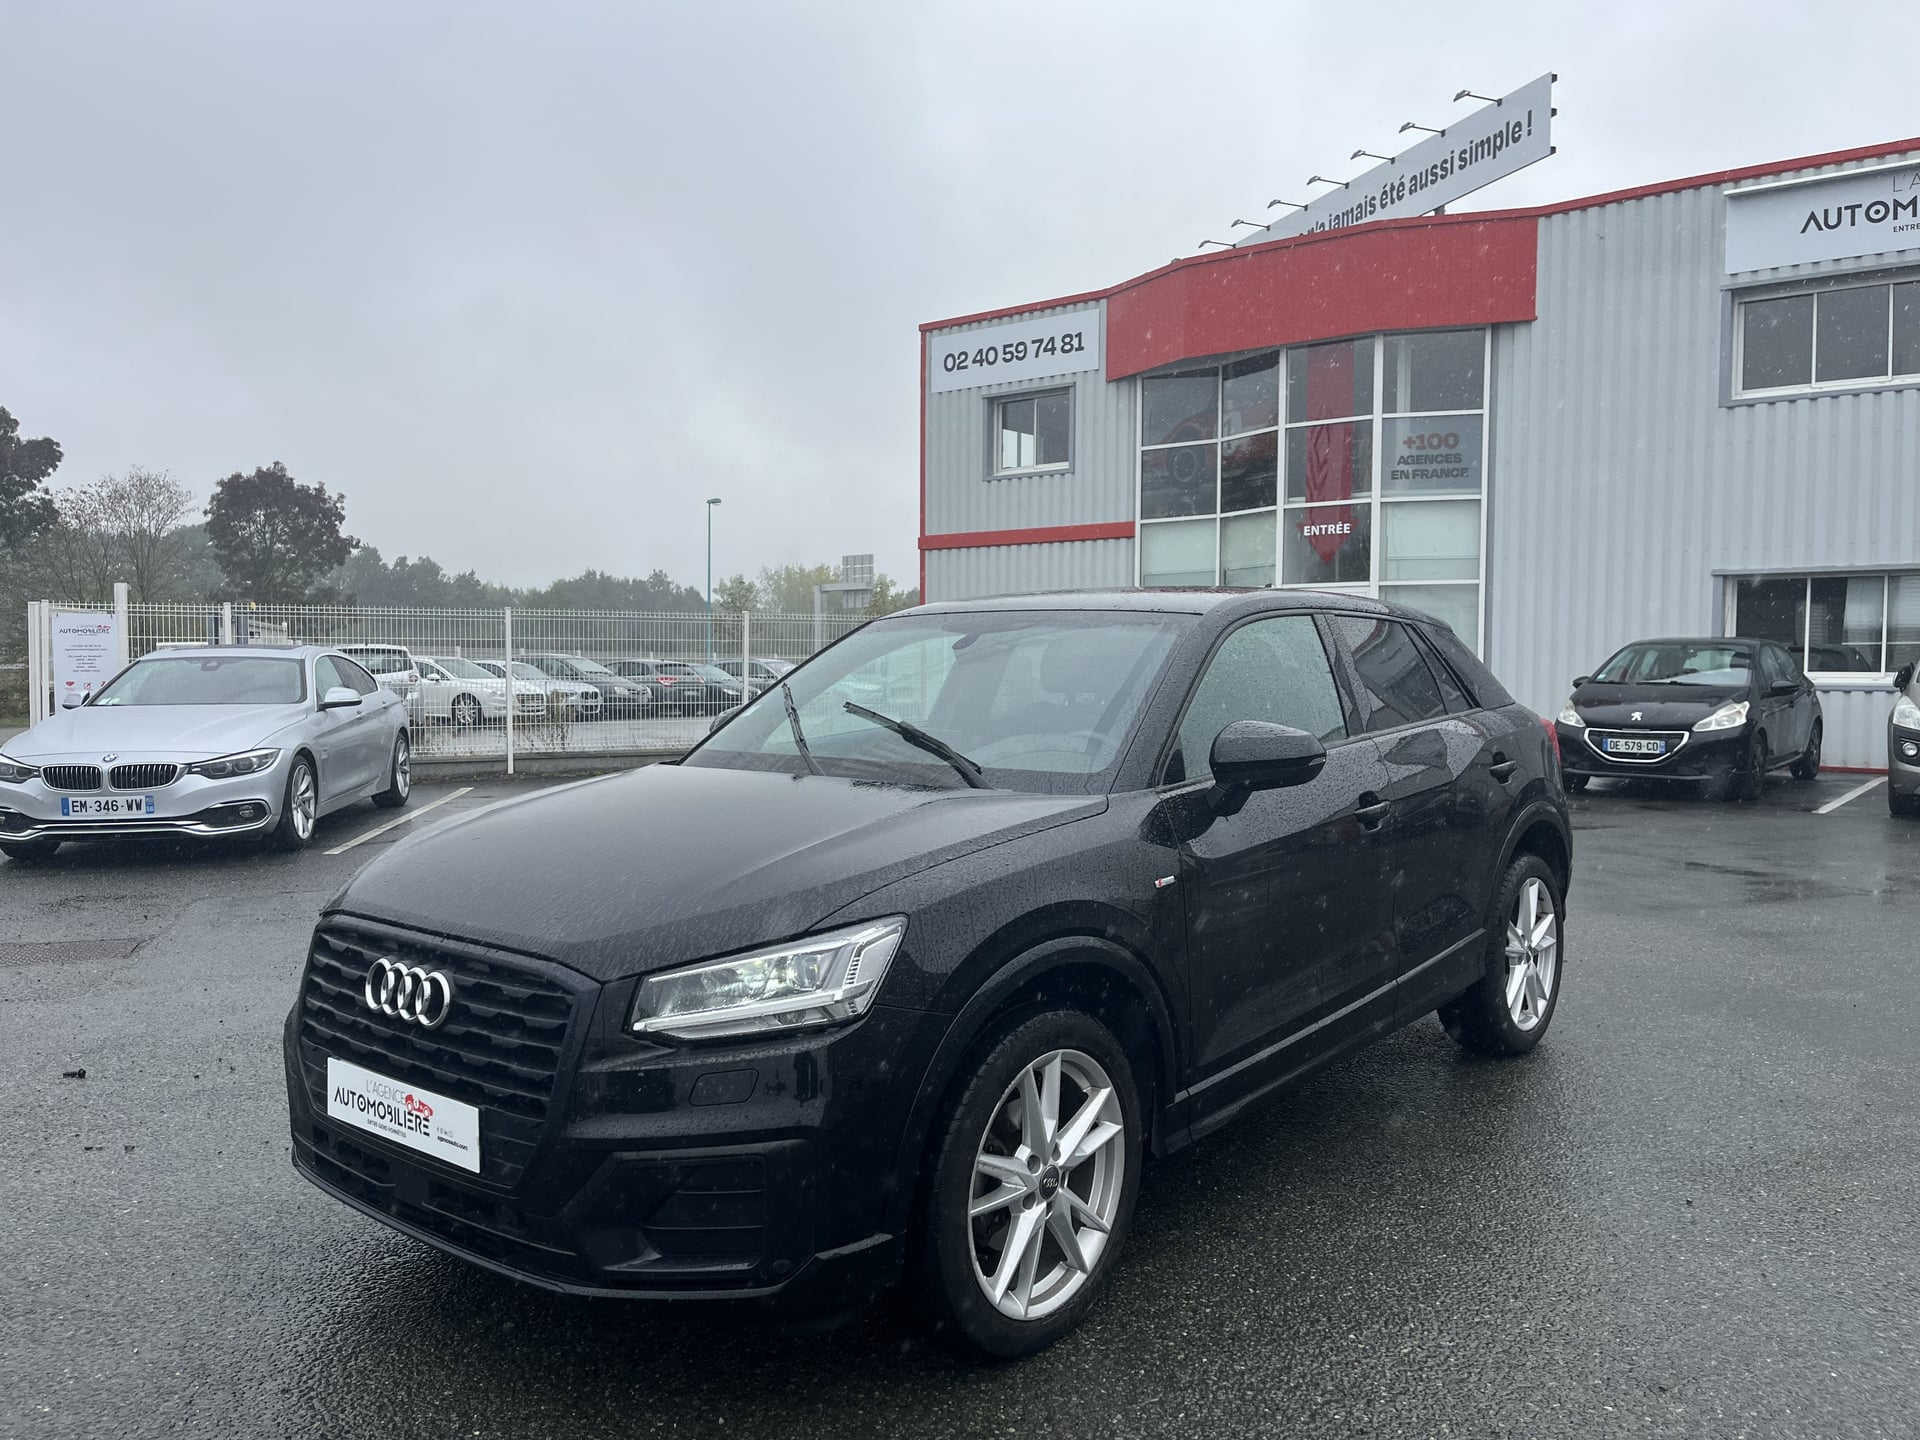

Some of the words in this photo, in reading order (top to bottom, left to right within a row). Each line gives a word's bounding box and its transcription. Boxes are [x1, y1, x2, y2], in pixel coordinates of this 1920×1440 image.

[1328, 195, 1377, 230] jamais
[1380, 174, 1406, 210] été
[1408, 150, 1455, 196] aussi
[1458, 120, 1523, 171] simple
[1800, 195, 1918, 234] AUTOM
[943, 351, 969, 372] 02
[972, 346, 998, 367] 40
[1002, 341, 1028, 363] 59
[1031, 336, 1057, 358] 74
[1060, 331, 1085, 354] 81
[1402, 432, 1460, 450] +100
[1396, 453, 1463, 466] AGENCES
[1391, 469, 1410, 480] EN
[1303, 521, 1351, 536] ENTRÉE
[366, 1079, 406, 1105] L'AGENCE
